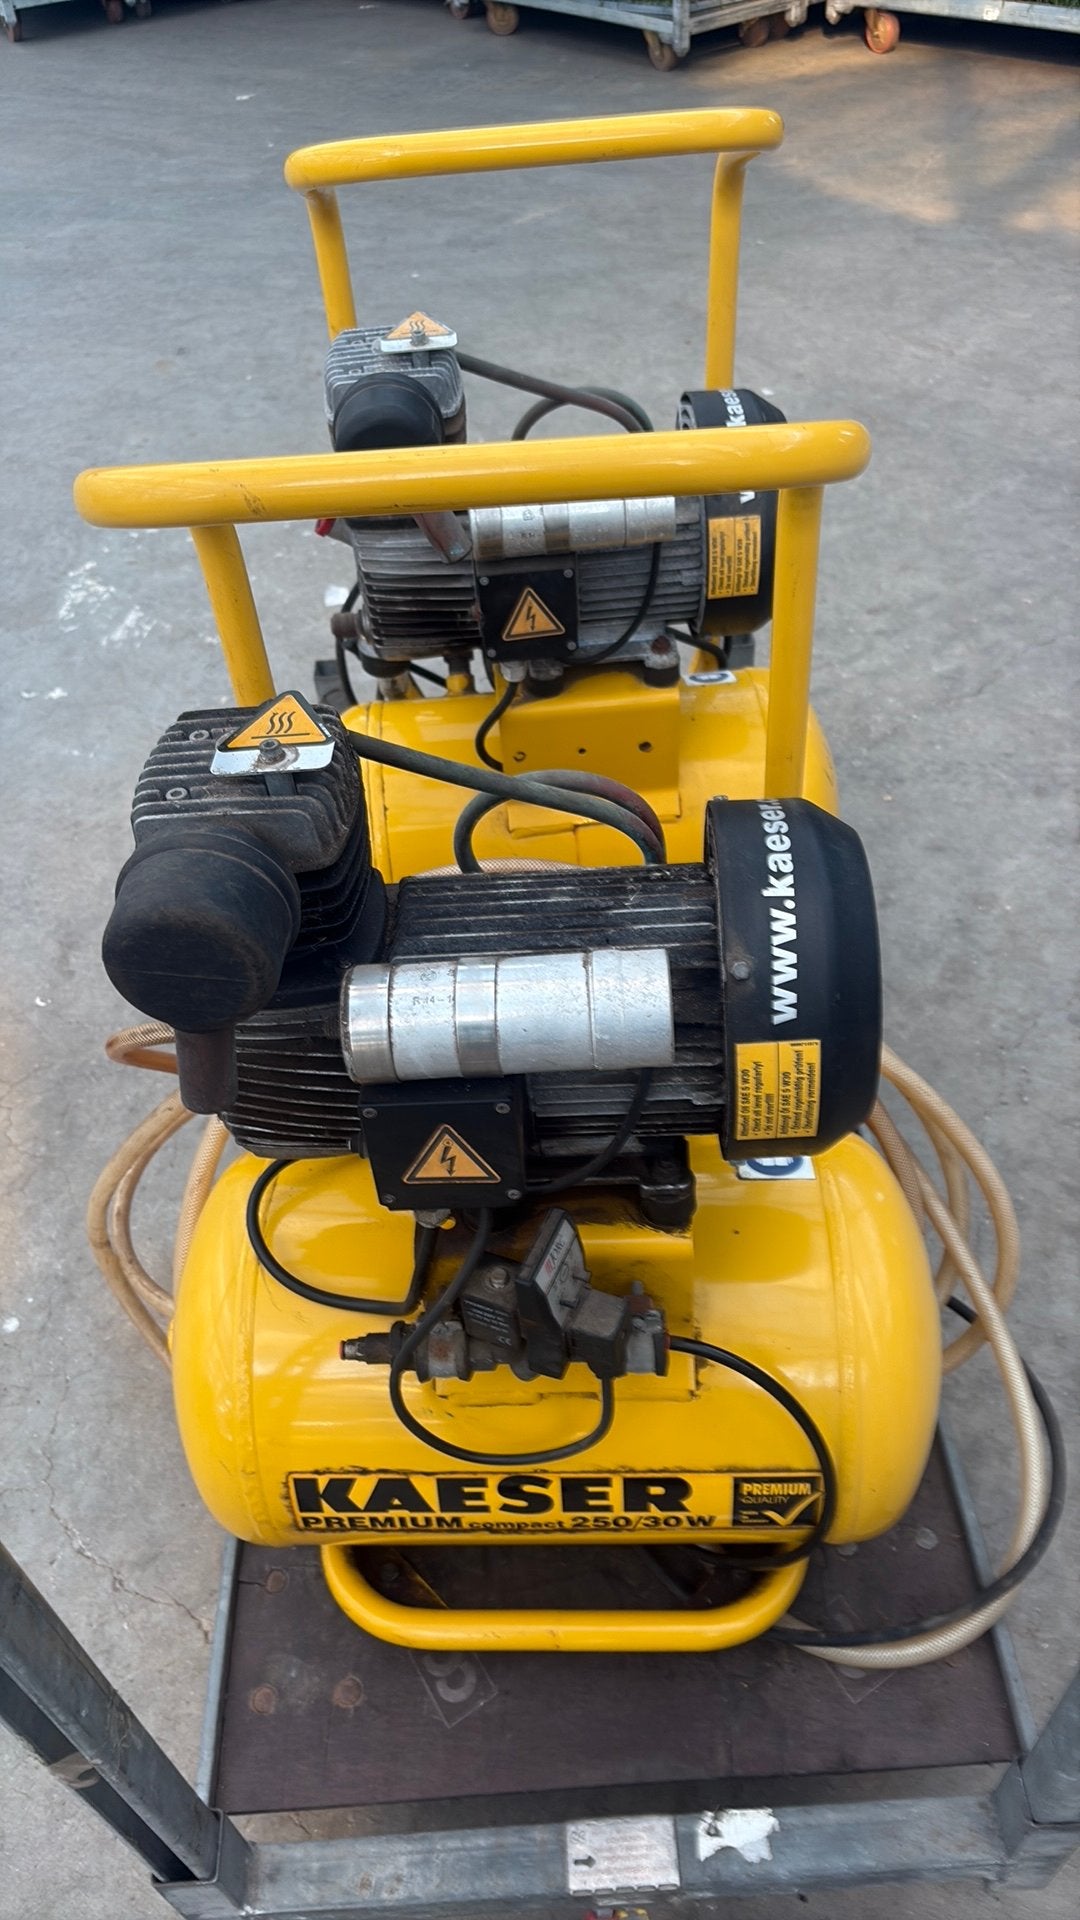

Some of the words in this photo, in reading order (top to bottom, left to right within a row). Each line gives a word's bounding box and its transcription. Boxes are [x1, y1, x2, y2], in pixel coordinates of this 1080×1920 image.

[741, 1093, 751, 1105] SAE
[781, 1094, 791, 1106] SAE
[293, 1475, 691, 1514] KAESER
[742, 1482, 812, 1495] PREMIUM
[741, 1496, 790, 1504] QUALITY
[301, 1516, 464, 1529] PREMIUM
[468, 1521, 565, 1533] compact
